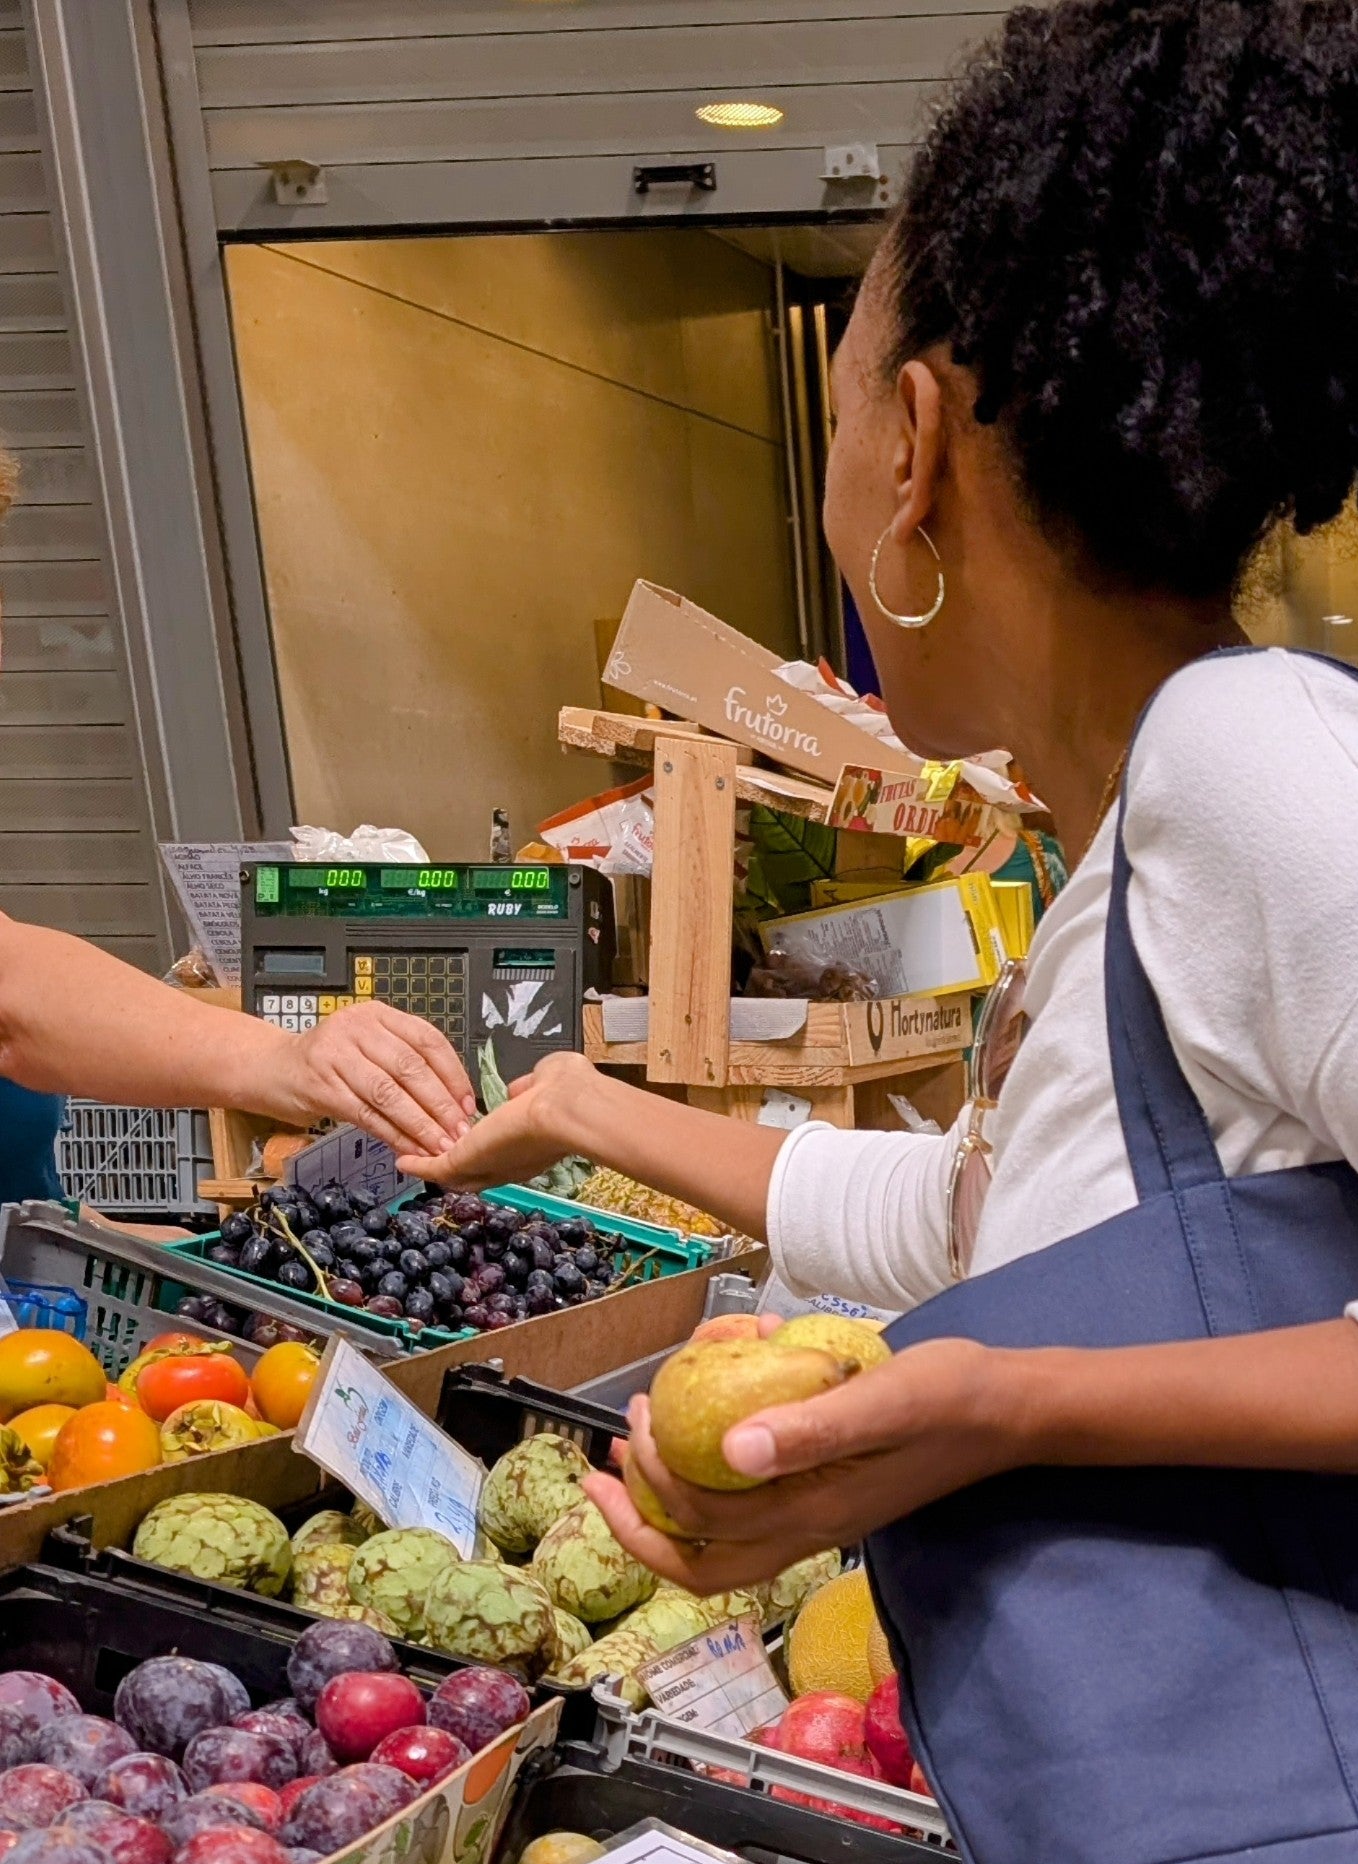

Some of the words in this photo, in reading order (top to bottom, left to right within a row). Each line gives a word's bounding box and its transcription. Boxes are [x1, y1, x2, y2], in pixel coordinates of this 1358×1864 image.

[724, 686, 821, 756] frutorra
[418, 870, 454, 887] 0.00
[511, 871, 548, 888] 0.00
[488, 903, 522, 916] RUBY
[268, 999, 275, 1010] 7
[286, 999, 293, 1010] 8
[304, 999, 312, 1011] 9
[286, 1019, 293, 1029] 5
[304, 1019, 312, 1029] 6
[890, 1000, 961, 1038] Hortynatura
